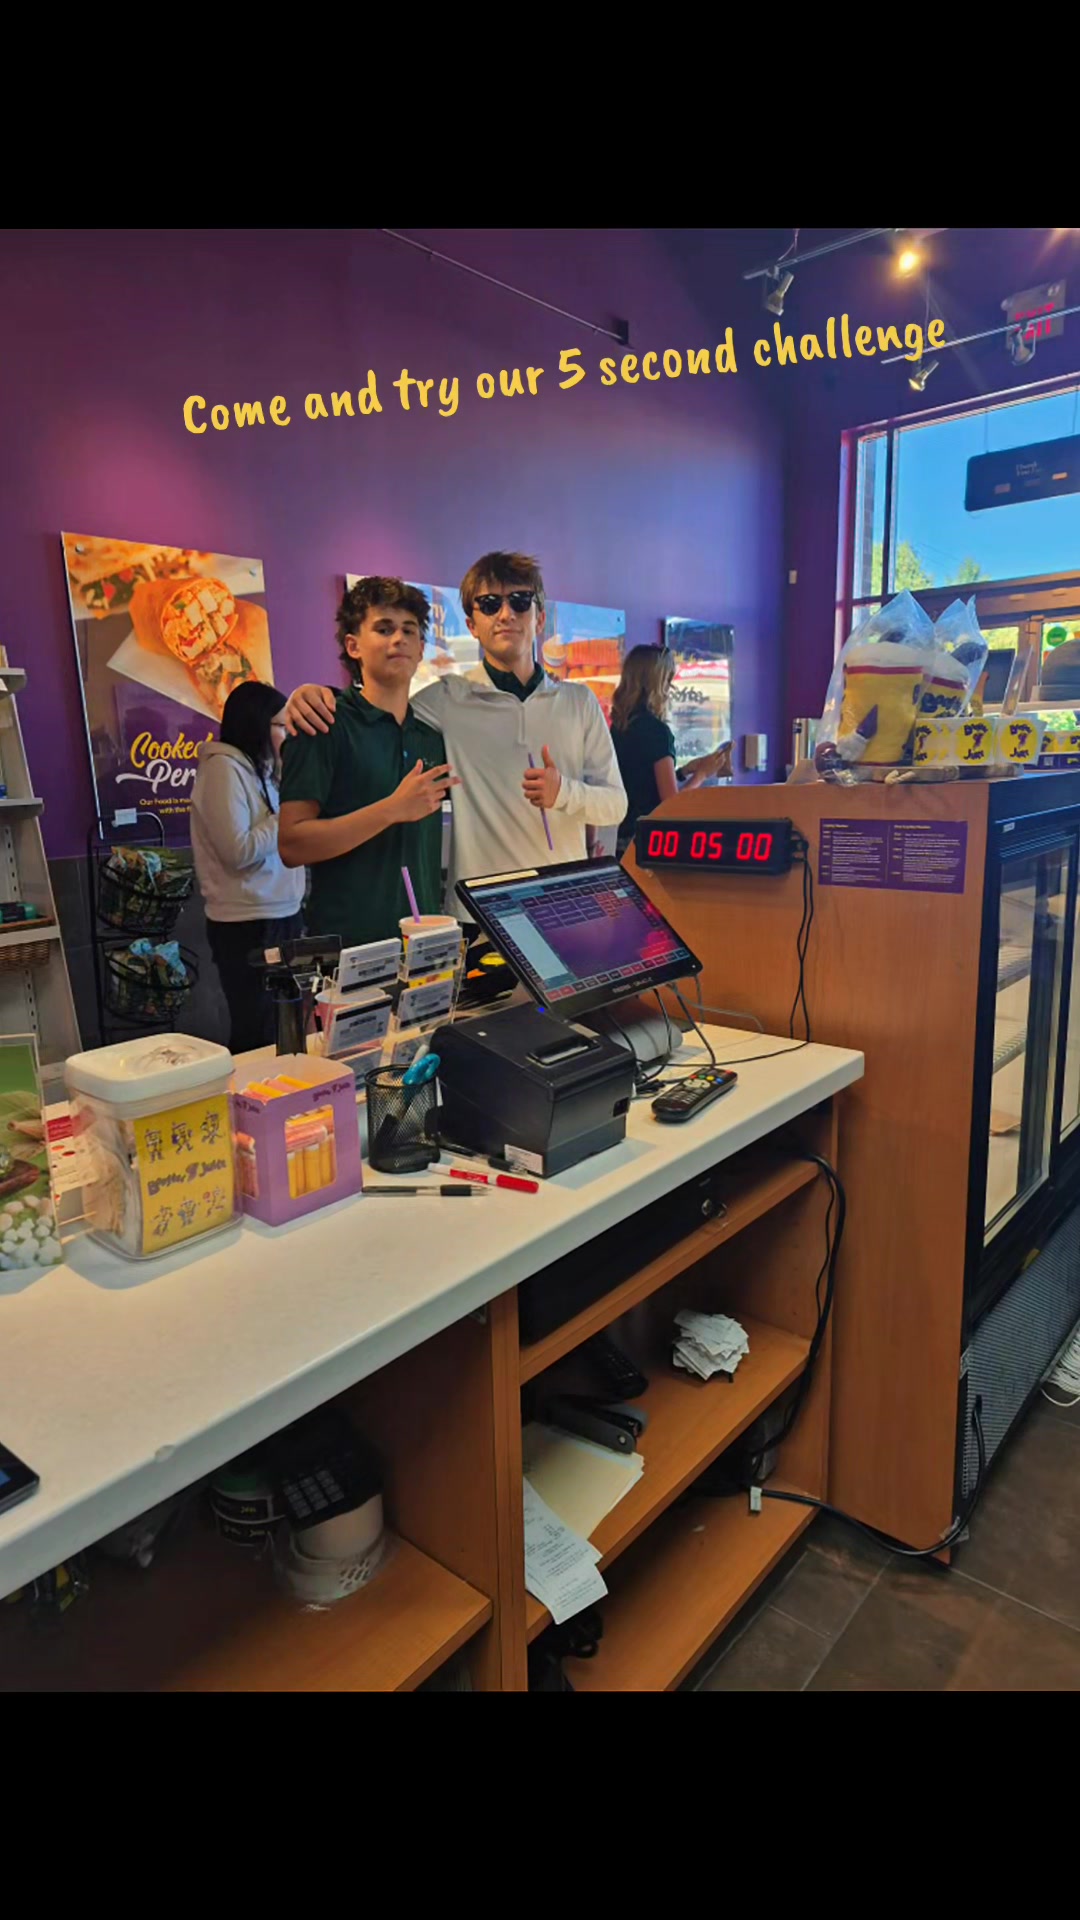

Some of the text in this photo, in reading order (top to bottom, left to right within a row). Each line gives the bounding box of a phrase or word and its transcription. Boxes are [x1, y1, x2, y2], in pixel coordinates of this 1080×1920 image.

[115, 759, 197, 794] Per
[647, 830, 773, 862] 00 05 00
